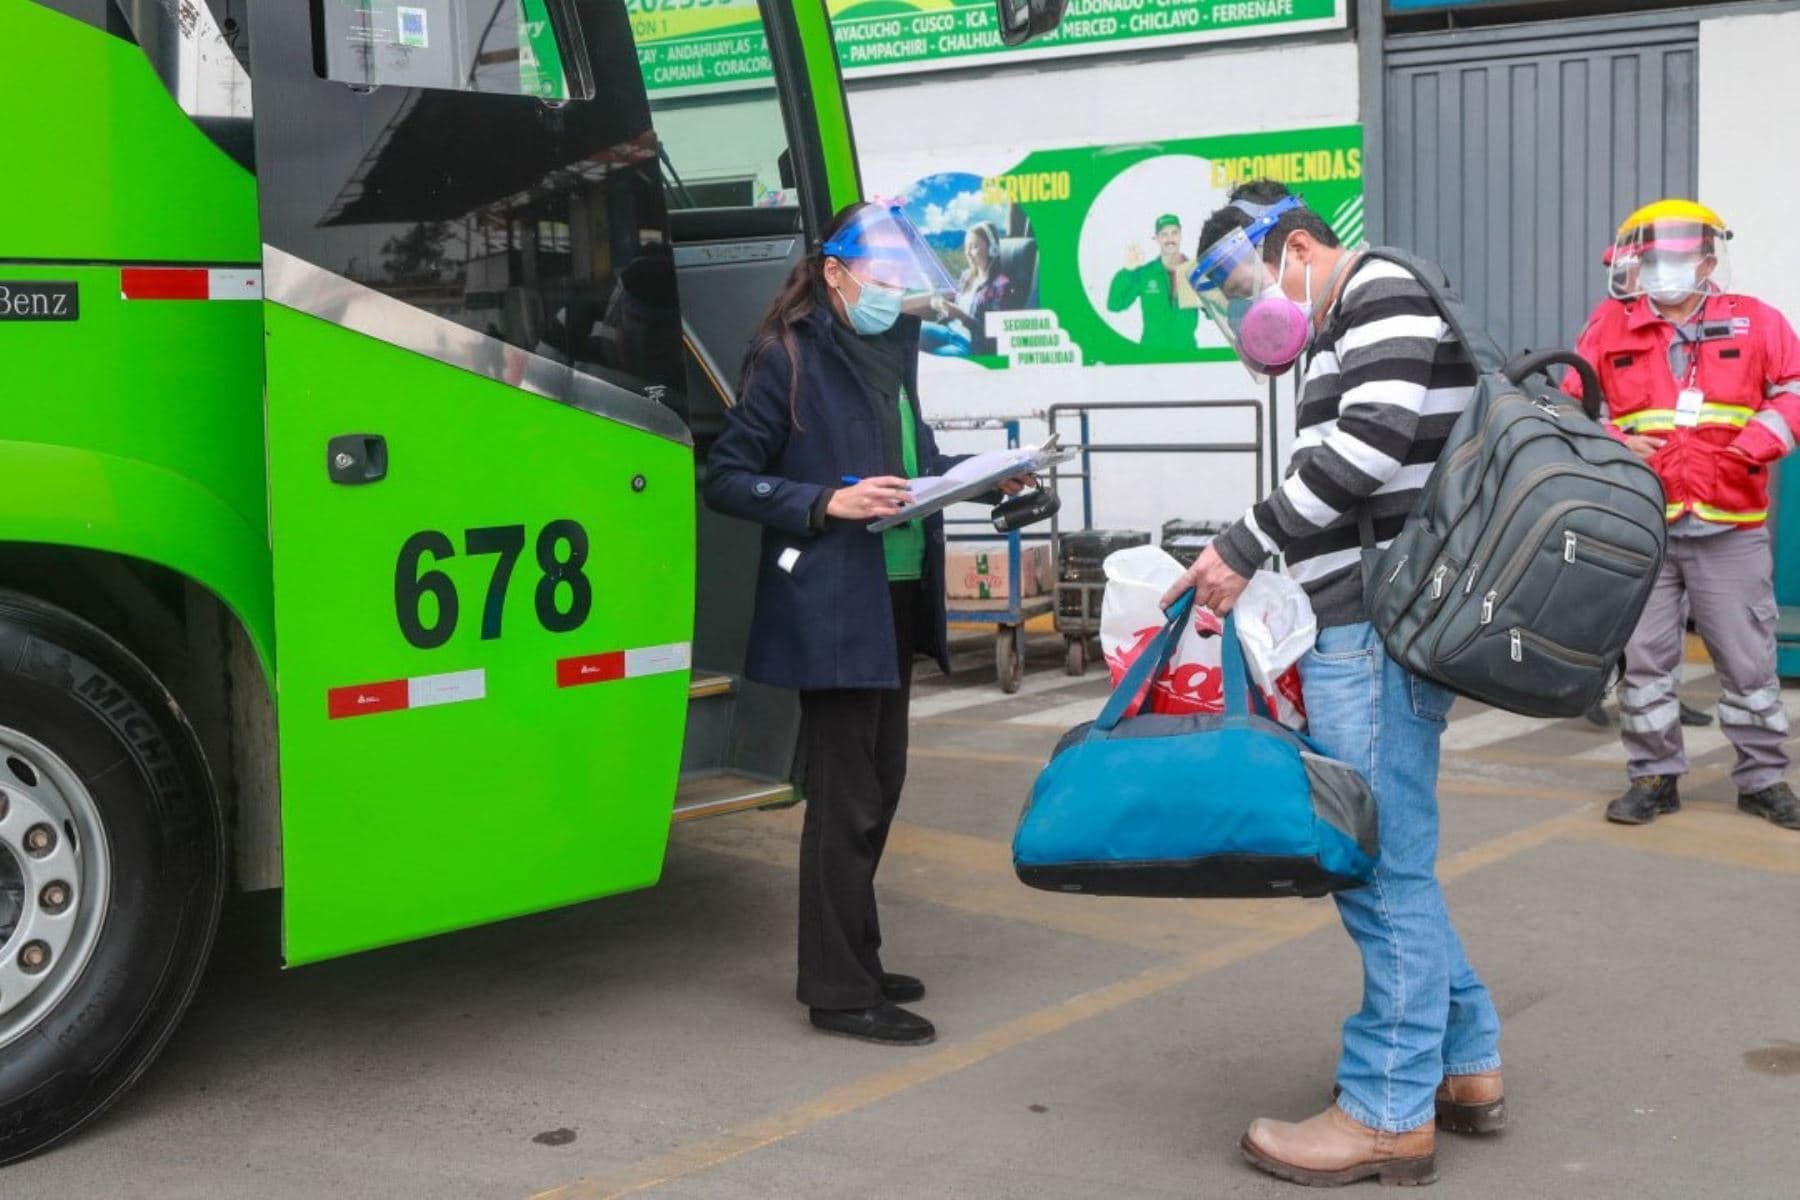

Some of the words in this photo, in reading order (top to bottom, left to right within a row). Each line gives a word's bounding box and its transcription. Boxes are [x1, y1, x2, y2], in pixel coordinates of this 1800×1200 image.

[667, 38, 750, 61] ANDAHUAYLAS
[835, 21, 900, 42] AYACUCHO
[911, 15, 954, 34] CUSCO
[965, 11, 988, 27] ICA
[1065, 0, 1143, 16] ALDONADO
[851, 39, 927, 61] PAMPACHIRI
[939, 31, 1004, 52] CHALHUA
[1063, 17, 1117, 39] MERCED
[1130, 8, 1199, 32] CHICLAYO
[982, 171, 1070, 205] SERVICIO
[1211, 148, 1362, 188] ENCOMIENDAS
[0, 285, 67, 315] Benz
[394, 518, 593, 650] 678
